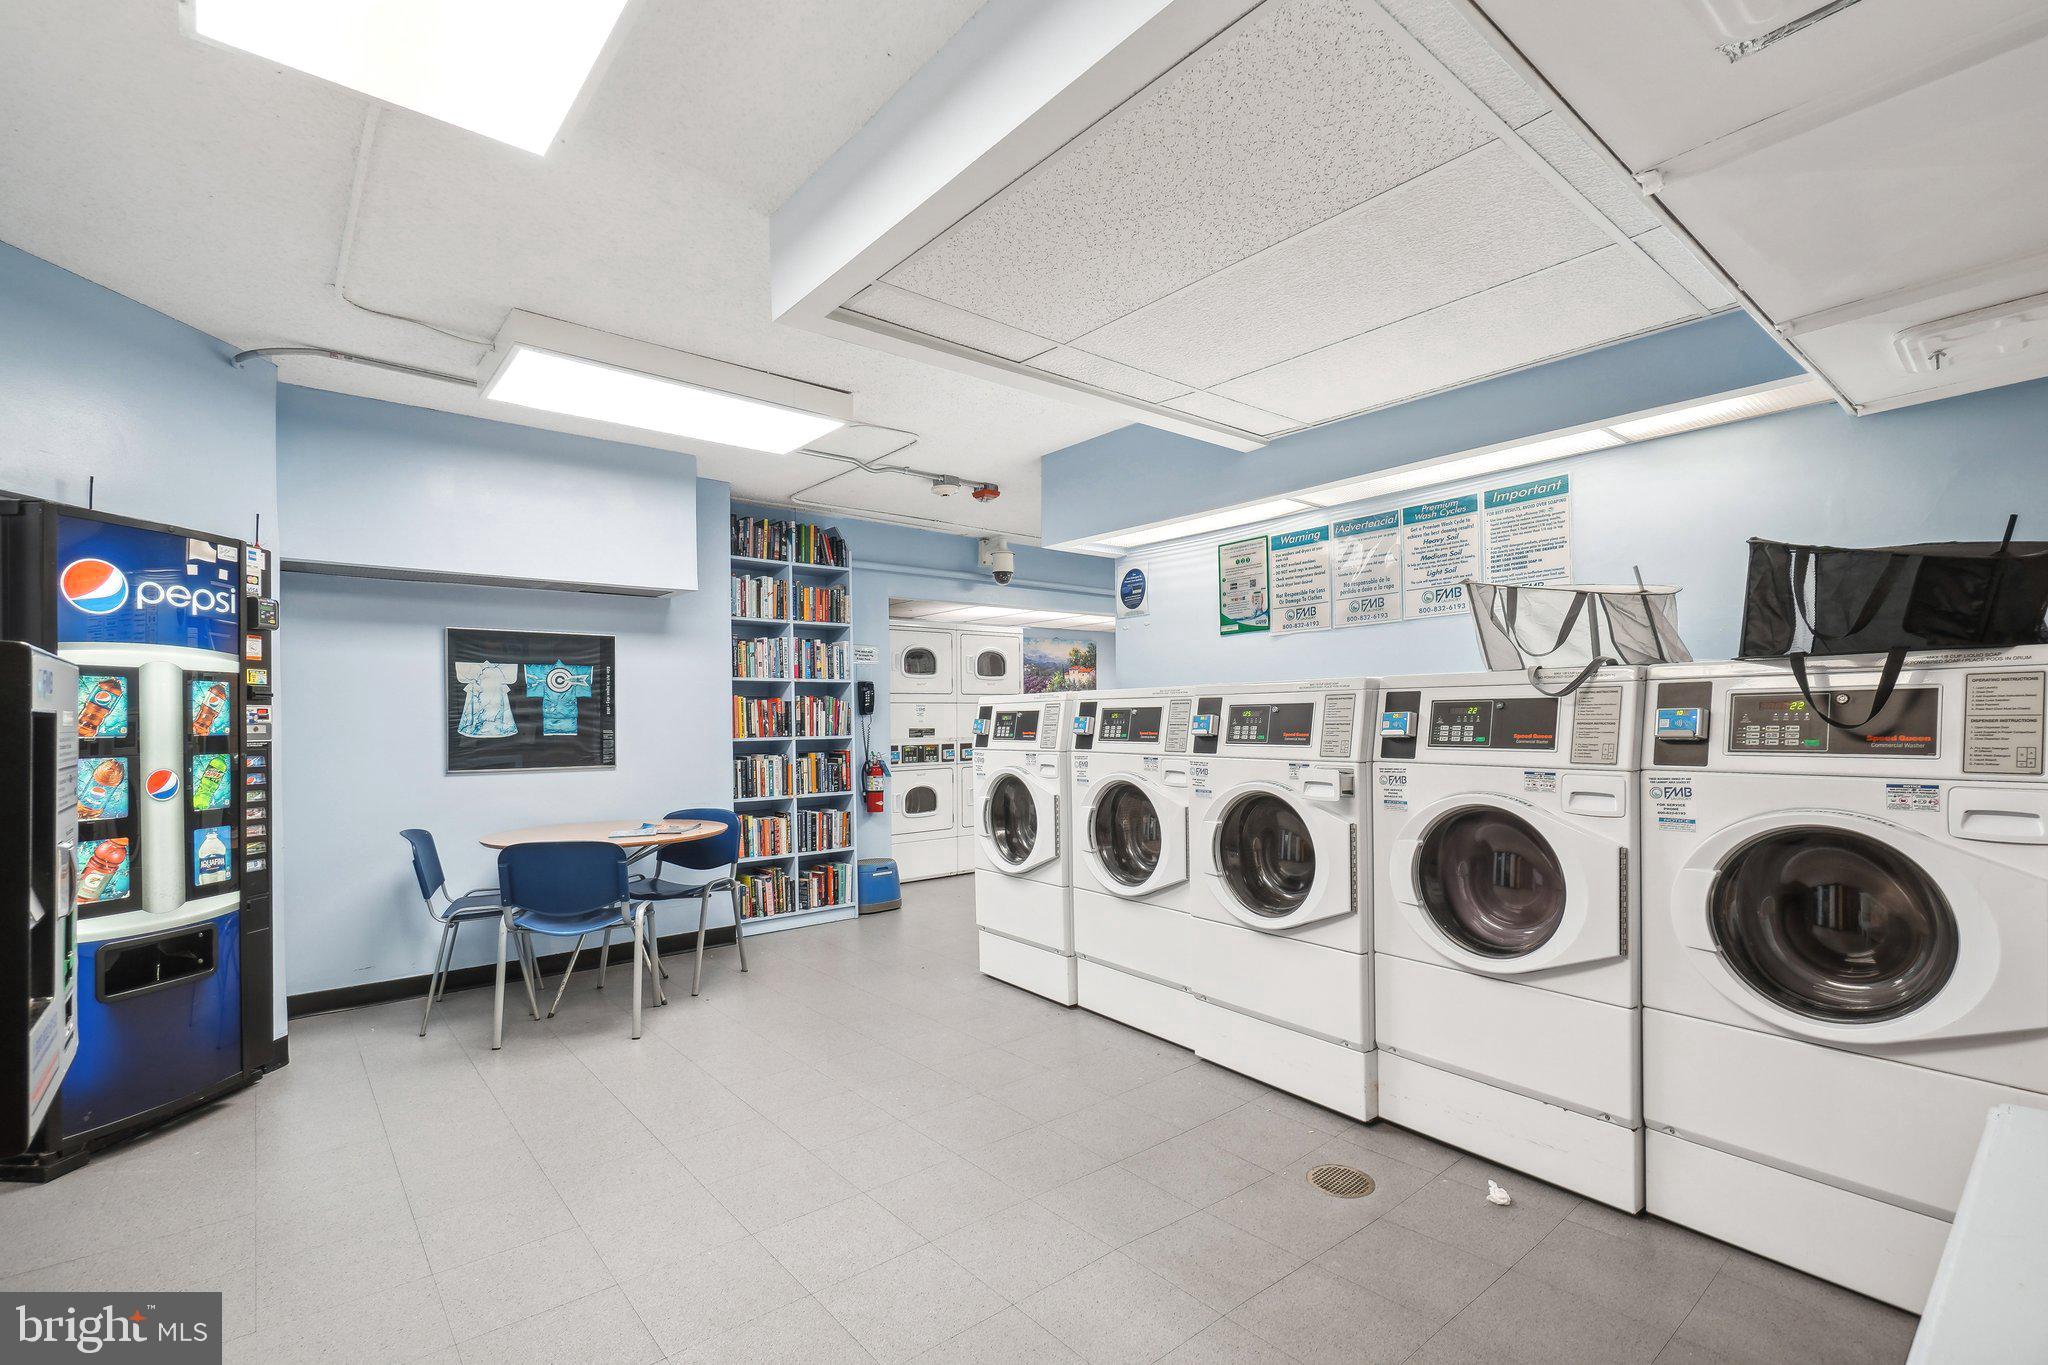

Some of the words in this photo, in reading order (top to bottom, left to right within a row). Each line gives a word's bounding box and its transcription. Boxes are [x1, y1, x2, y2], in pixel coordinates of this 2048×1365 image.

[1493, 480, 1562, 502] Important
[1422, 500, 1458, 512] Premium
[1415, 510, 1436, 520] Wash
[1440, 506, 1467, 517] Cycles
[1280, 532, 1320, 544] Warning
[1420, 552, 1447, 561] Medium
[1426, 569, 1442, 577] Light
[1351, 579, 1378, 588] responsable
[136, 581, 236, 616] pepsi
[1284, 590, 1308, 598] Responsible
[1436, 587, 1462, 602] FMB
[1361, 598, 1384, 612] FMB
[1418, 603, 1466, 614] 800-832-6193
[1296, 606, 1316, 620] FMB
[1346, 613, 1388, 622] 800-832-6193
[1283, 621, 1319, 629] 800-832-6193
[1467, 706, 1478, 714] 22
[1790, 701, 1804, 710] 22
[1866, 734, 1898, 742] Speed
[1898, 734, 1932, 742] Queen
[1388, 776, 1407, 786] FMB
[1664, 786, 1692, 800] FMB
